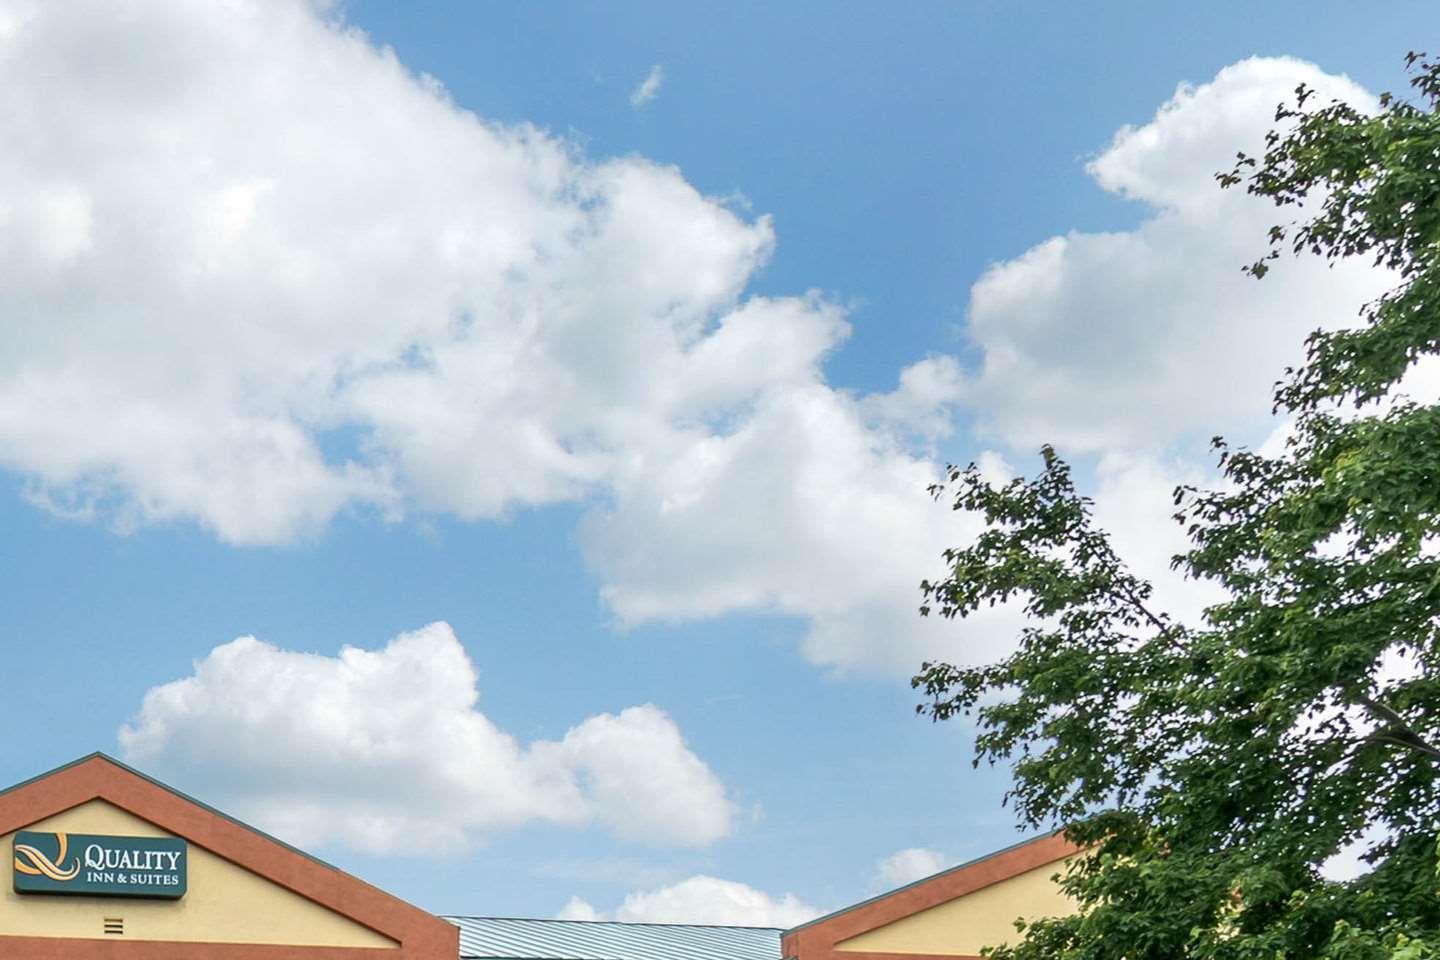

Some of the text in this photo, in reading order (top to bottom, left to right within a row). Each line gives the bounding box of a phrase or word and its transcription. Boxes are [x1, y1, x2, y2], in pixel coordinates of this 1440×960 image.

[84, 844, 181, 871] QUALITY
[86, 872, 179, 885] INN & SUITES
